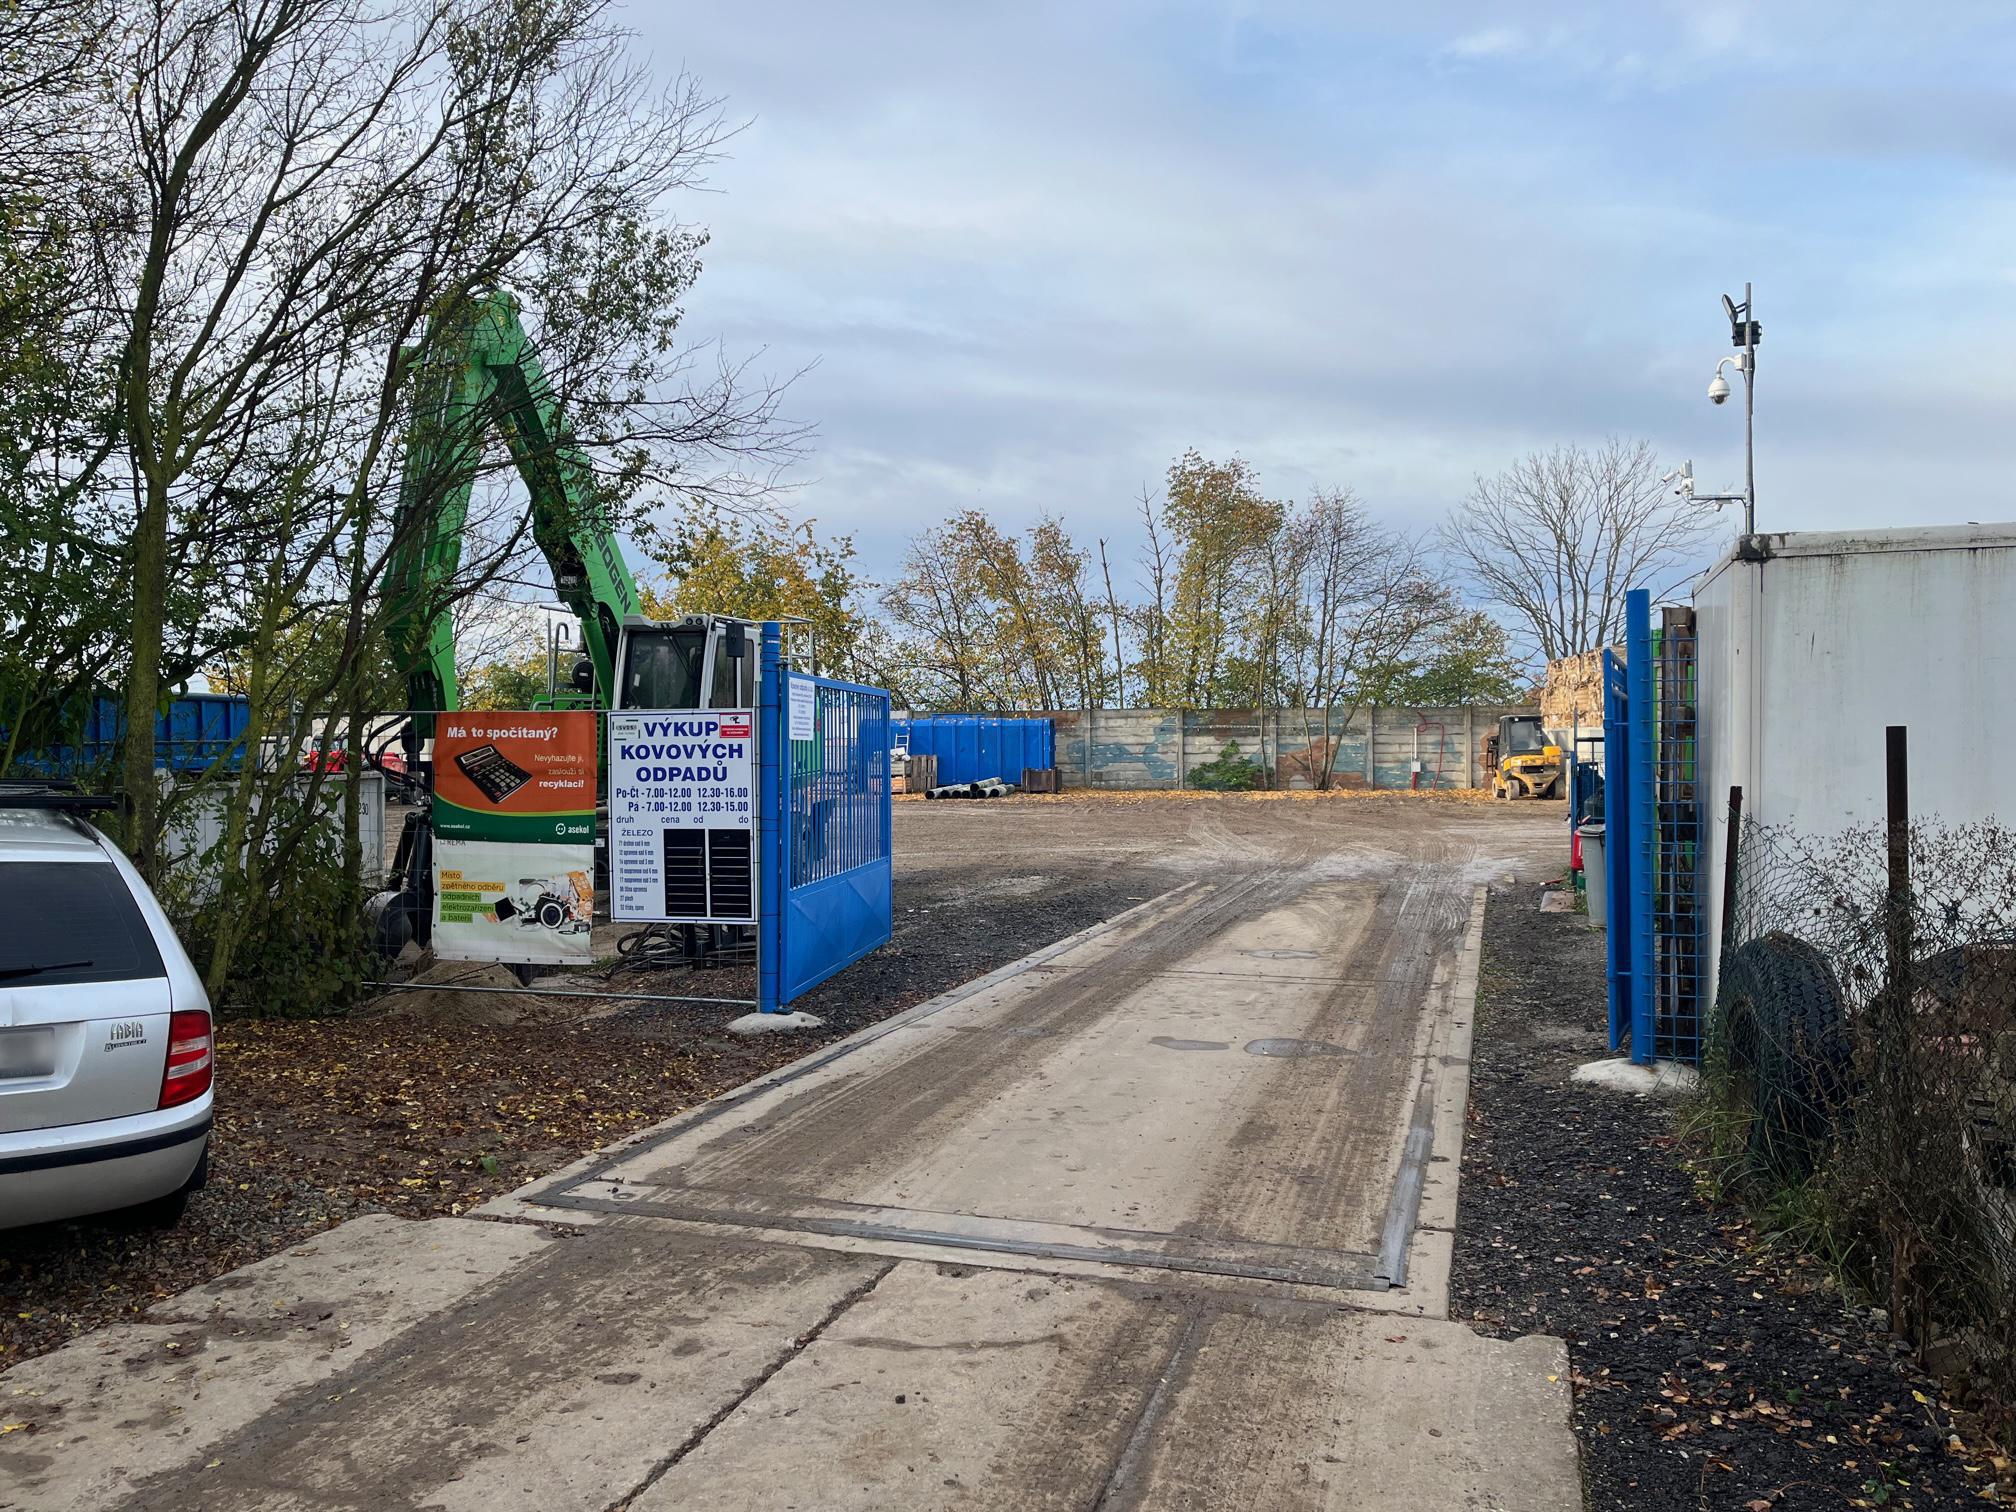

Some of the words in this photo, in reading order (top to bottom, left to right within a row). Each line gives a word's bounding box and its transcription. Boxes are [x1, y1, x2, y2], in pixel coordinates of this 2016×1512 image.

[644, 717, 718, 737] VÝKUP
[447, 726, 466, 738] Má
[471, 727, 484, 738] to
[487, 726, 558, 740] spočítaný?
[620, 739, 743, 759] KOVOVÝCH
[534, 754, 576, 763] Nevyhazujte
[636, 760, 727, 782] ODPADŮ
[539, 780, 584, 788] recyklaci!
[616, 786, 639, 798] Po-Čt
[646, 788, 692, 798] 7.00-12.00
[697, 788, 748, 798] 12.30-16.00
[628, 801, 639, 812] Pá
[646, 802, 692, 812] 7.00-12.00
[697, 802, 748, 812] 12.30-15.00
[568, 824, 590, 834] asekol
[621, 828, 654, 836] ŽELEZO
[441, 882, 476, 890] zpětného
[478, 883, 504, 892] odběru
[441, 903, 494, 912] elektrozařízení
[110, 1021, 144, 1040] FABIA
